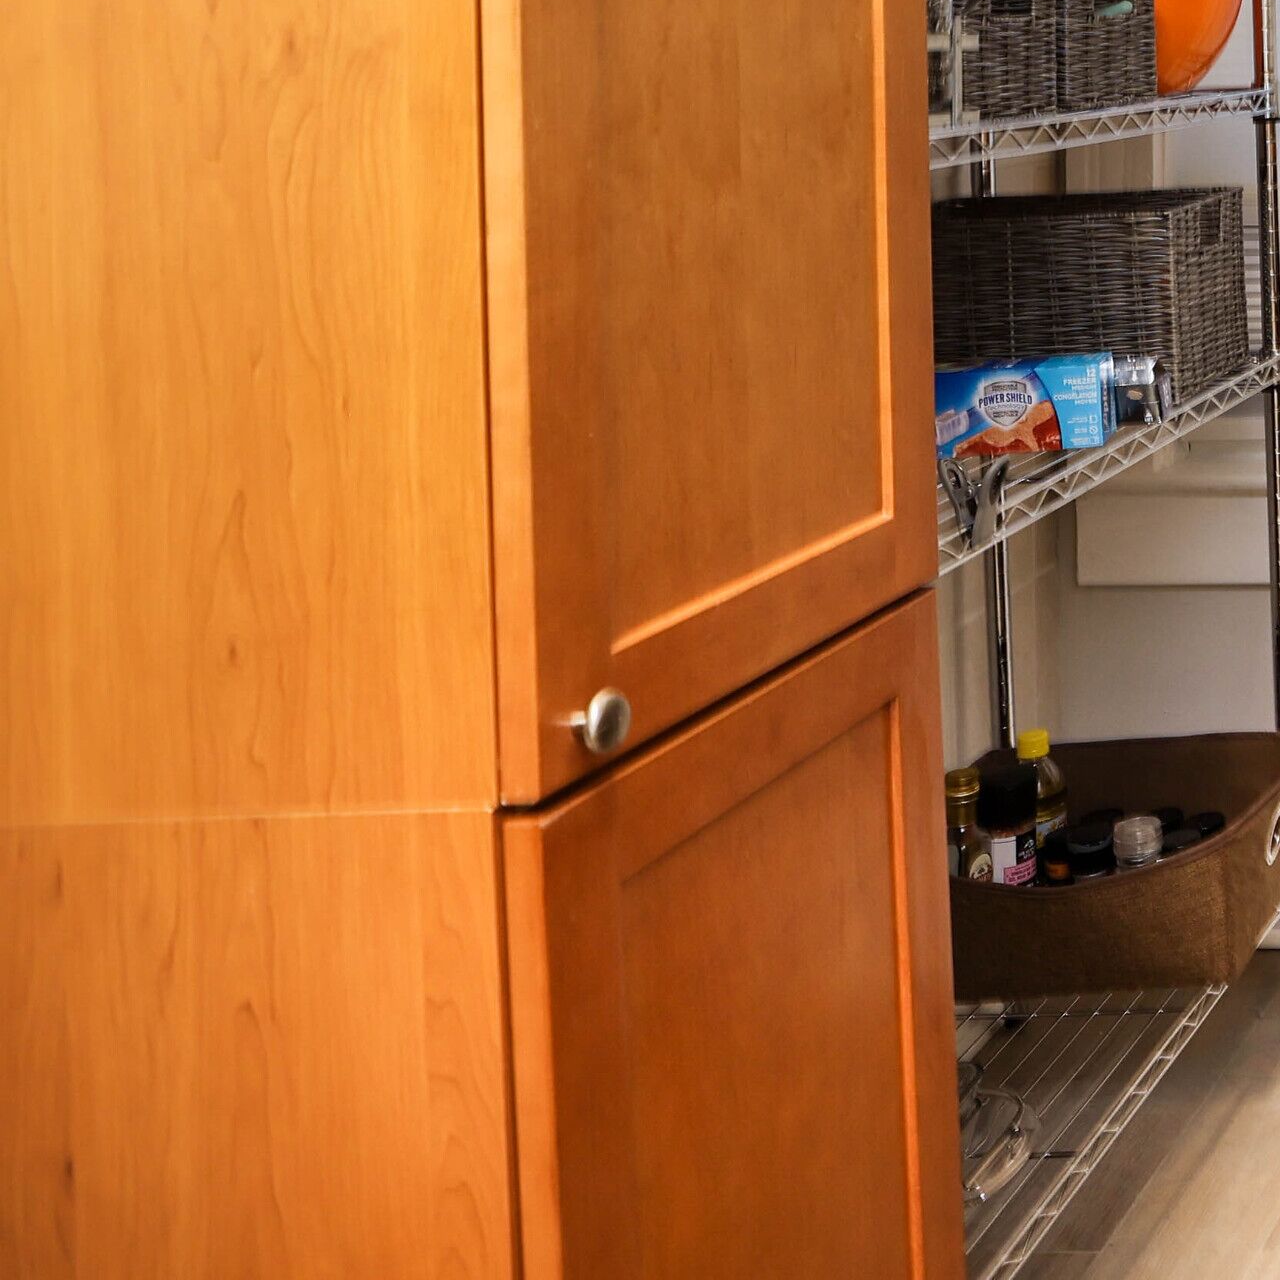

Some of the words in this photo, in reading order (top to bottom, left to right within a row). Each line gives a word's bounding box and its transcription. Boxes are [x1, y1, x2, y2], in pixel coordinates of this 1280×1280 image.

[1087, 368, 1096, 376] 12
[1063, 377, 1096, 385] FREEZER
[979, 393, 1005, 408] POWER
[1005, 393, 1033, 405] SHIELD
